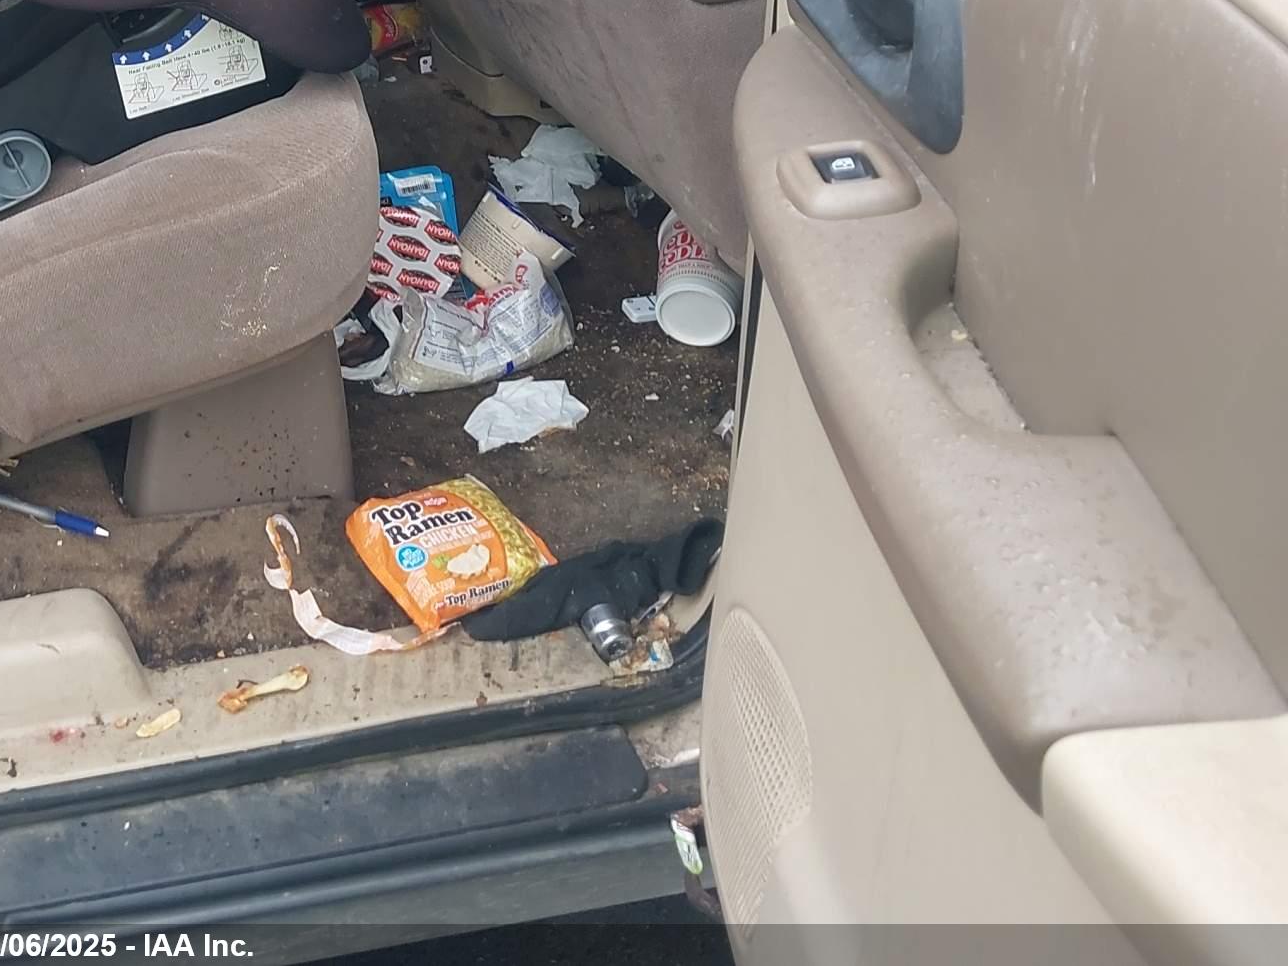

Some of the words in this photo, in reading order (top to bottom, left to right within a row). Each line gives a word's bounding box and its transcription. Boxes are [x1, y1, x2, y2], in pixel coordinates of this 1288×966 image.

[389, 239, 429, 257] IDAHOAN
[398, 274, 438, 290] IDAHOAN
[371, 501, 422, 526] Top
[385, 509, 475, 546] Ramen
[419, 524, 478, 548] CHICKEN
[445, 593, 467, 605] Top
[469, 579, 510, 599] Ramen
